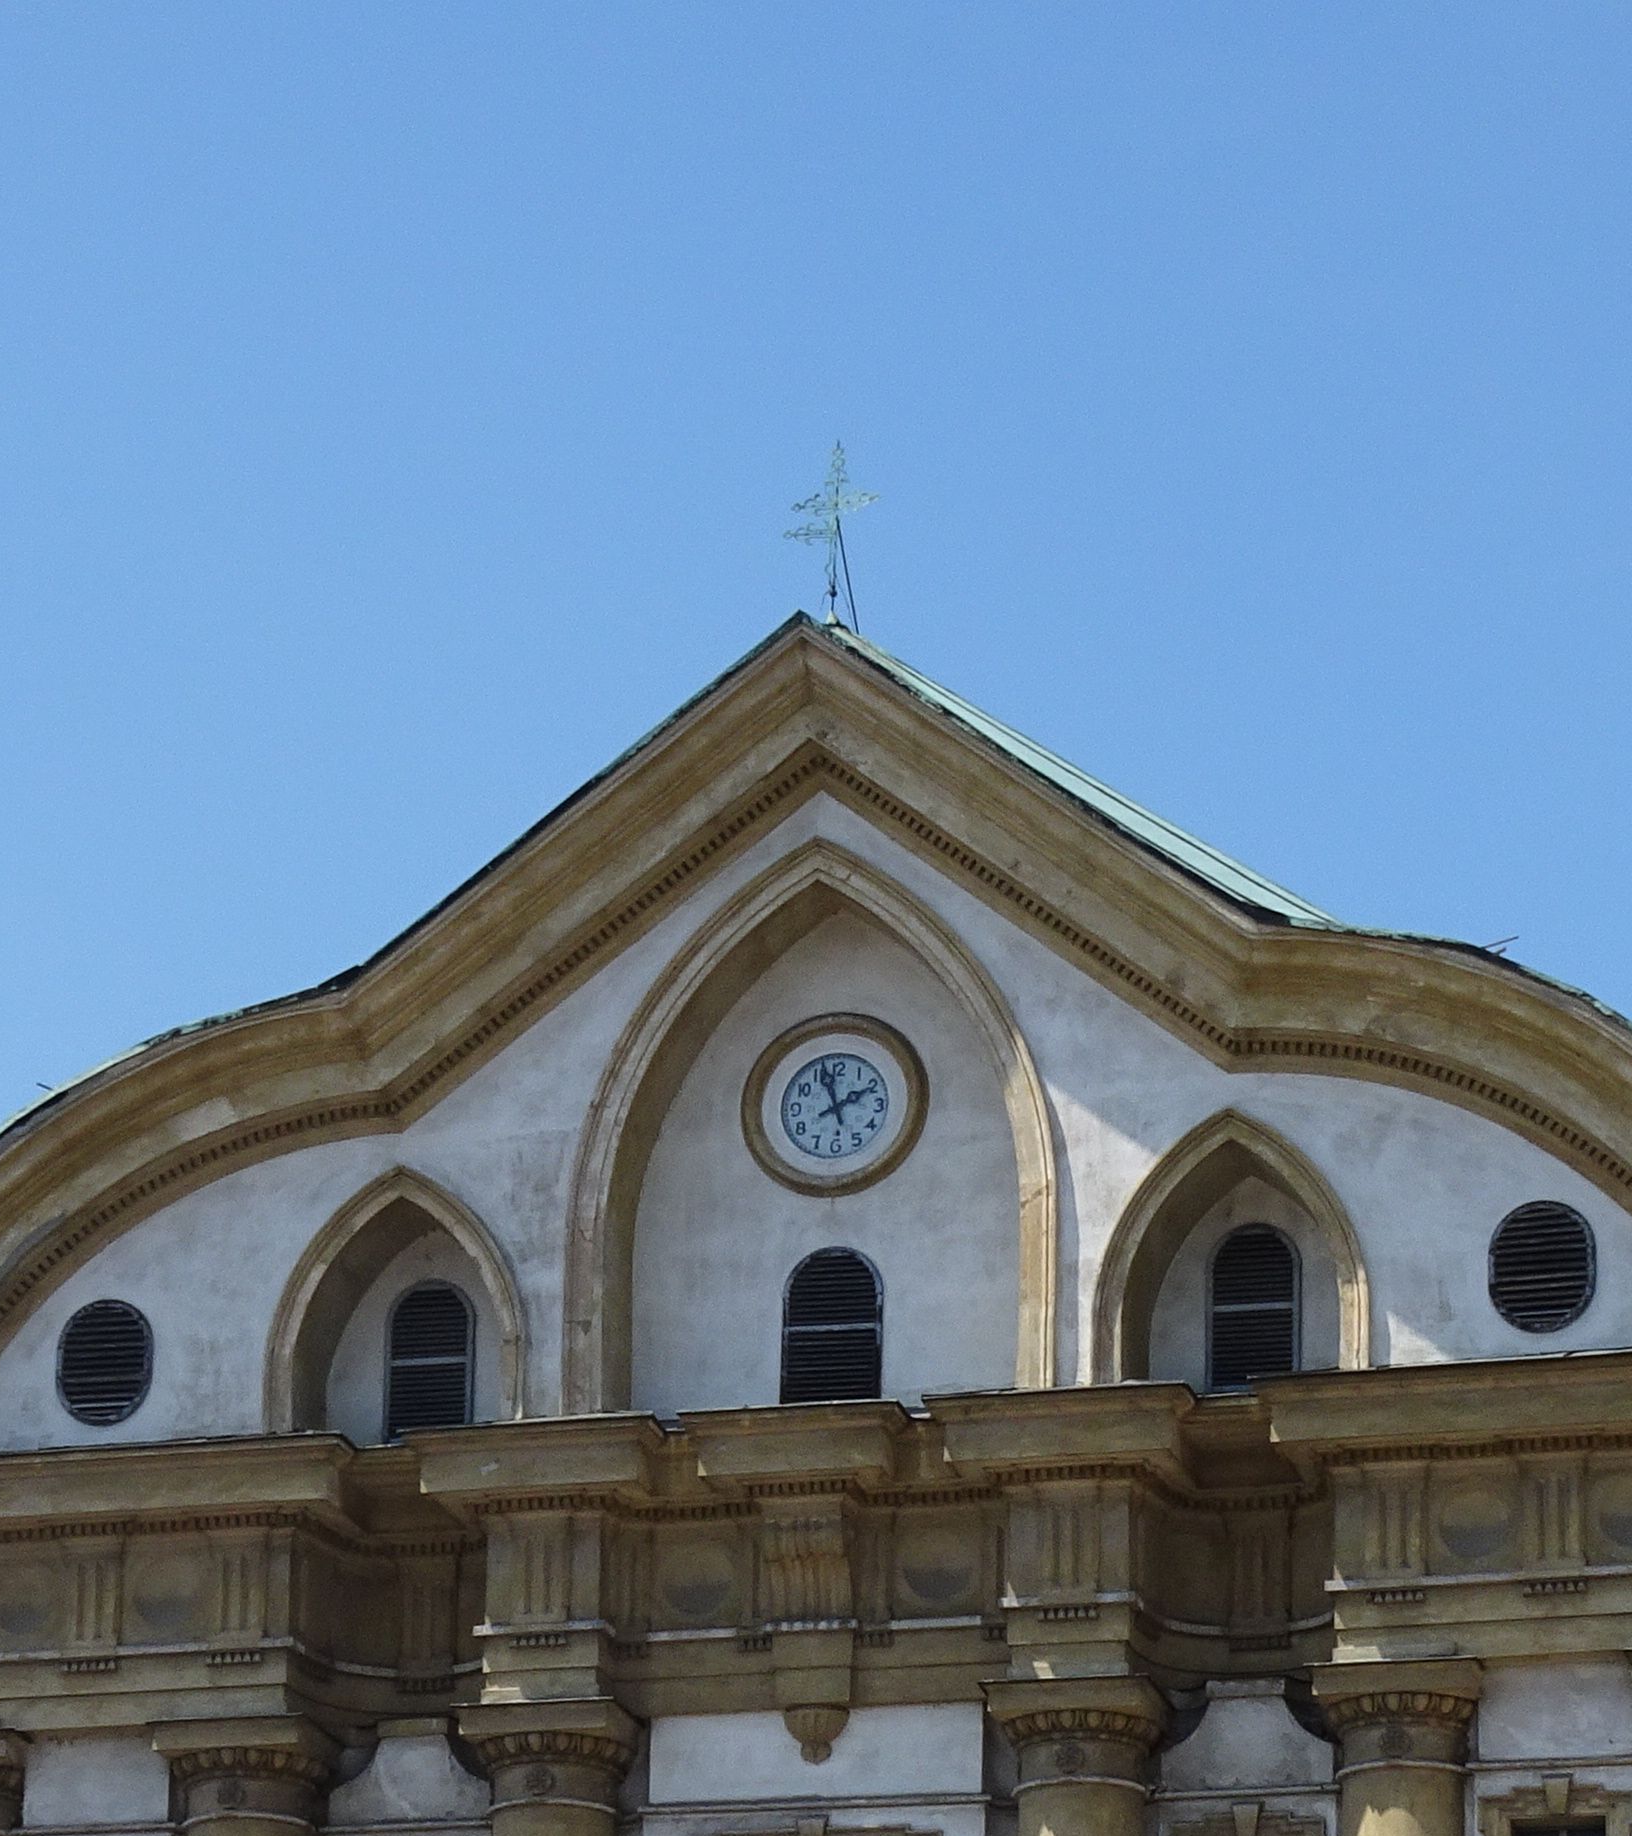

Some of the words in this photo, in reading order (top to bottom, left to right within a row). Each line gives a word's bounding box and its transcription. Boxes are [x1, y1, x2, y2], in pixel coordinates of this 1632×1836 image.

[832, 1062, 846, 1076] 12
[798, 1083, 811, 1097] 10
[868, 1079, 878, 1093] 2
[790, 1103, 801, 1117] 9
[874, 1098, 884, 1113] 3
[796, 1121, 806, 1135] 8
[864, 1117, 877, 1131] 4
[811, 1135, 821, 1150] 7
[830, 1139, 842, 1154] 6
[851, 1133, 862, 1147] 5
